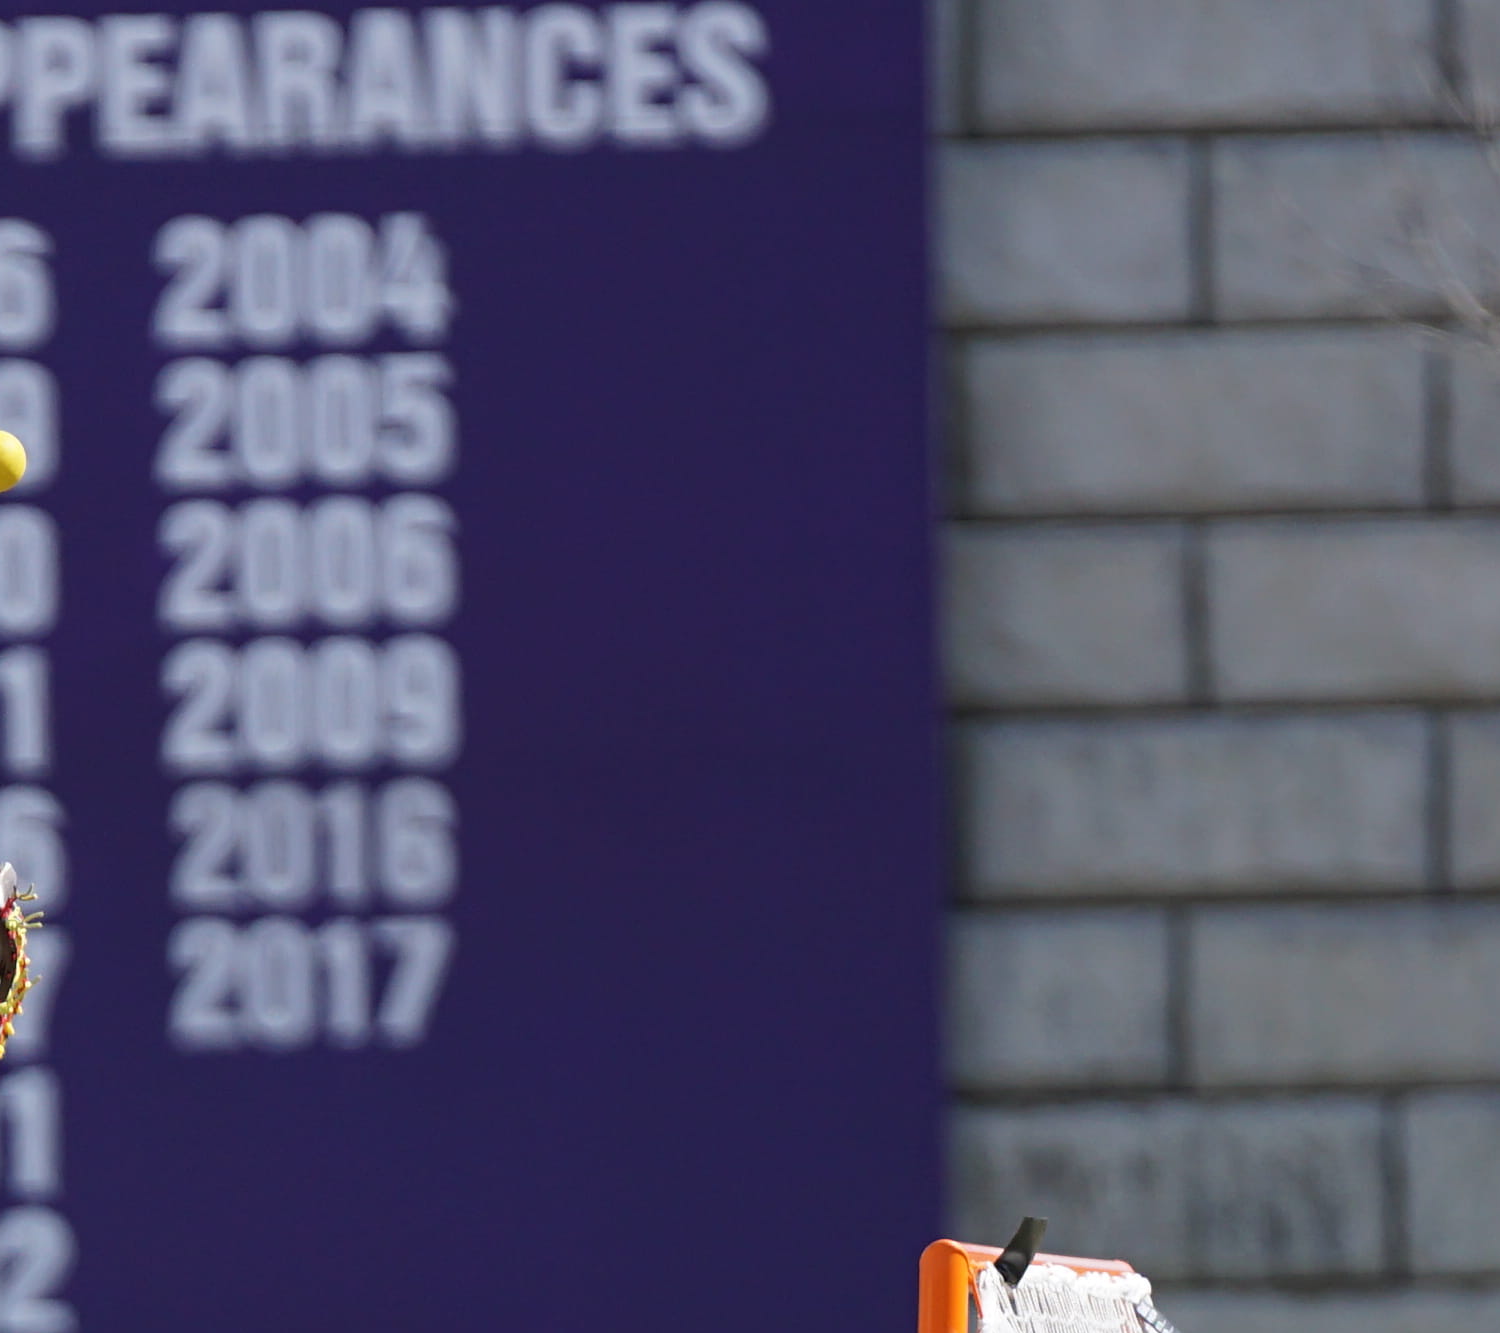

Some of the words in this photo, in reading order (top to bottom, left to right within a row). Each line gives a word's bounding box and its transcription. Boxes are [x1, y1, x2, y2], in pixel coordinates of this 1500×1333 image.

[154, 213, 452, 348] 2004
[156, 353, 455, 489] 2005
[160, 495, 457, 630] 2006
[162, 635, 460, 772] 2009
[172, 778, 456, 909] 2016
[171, 916, 453, 1046] 2017
